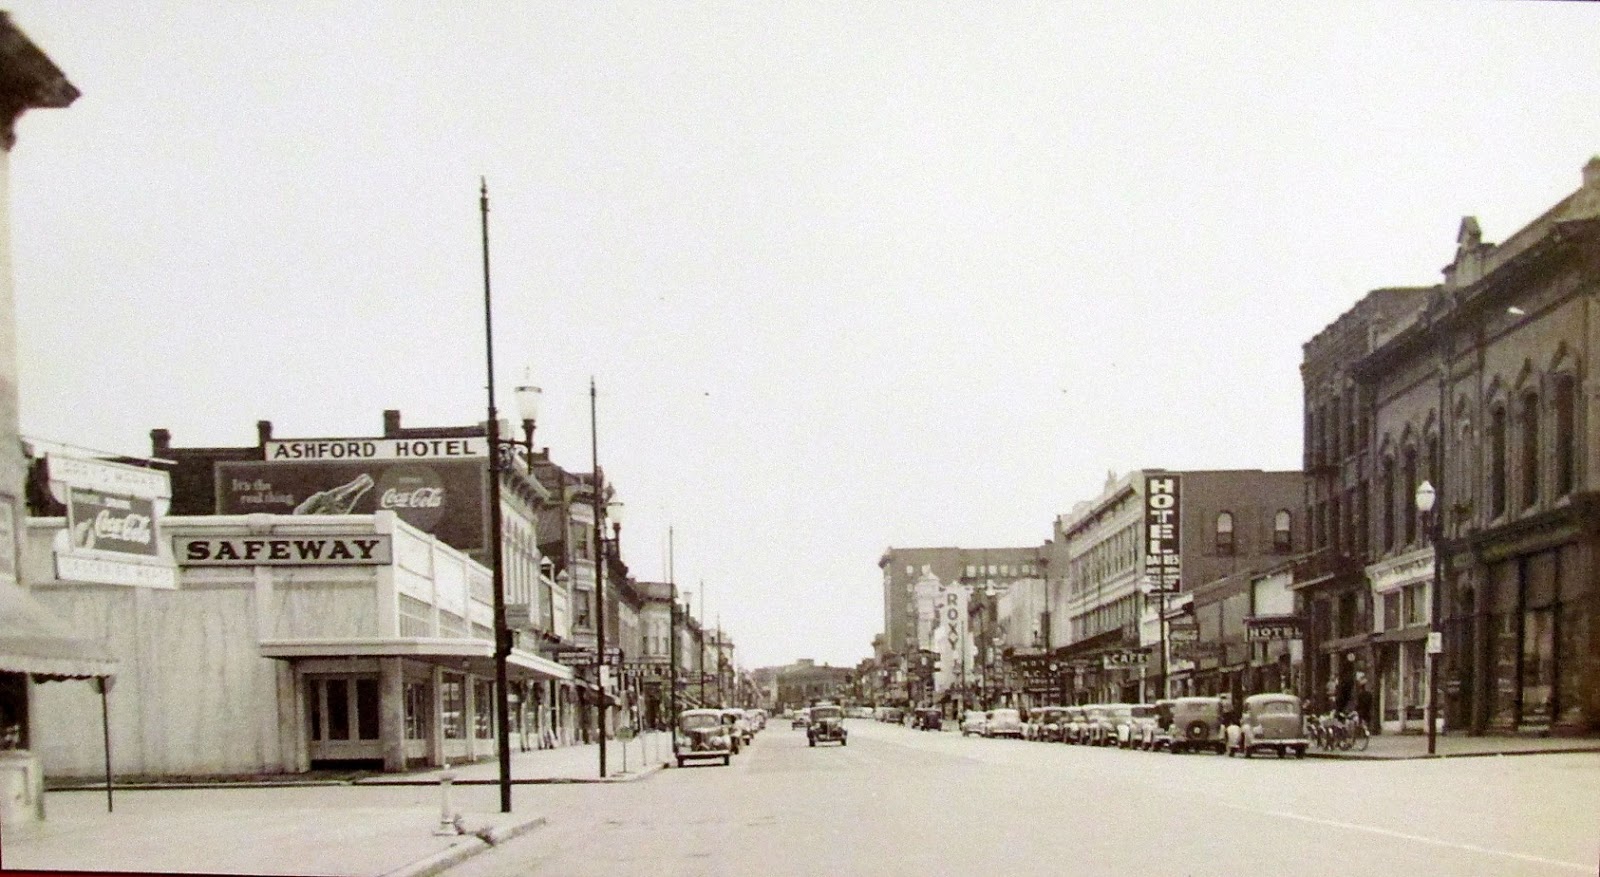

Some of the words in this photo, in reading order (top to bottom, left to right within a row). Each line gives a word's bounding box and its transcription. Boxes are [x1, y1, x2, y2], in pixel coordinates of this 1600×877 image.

[274, 442, 376, 459] ASHFORD
[396, 439, 477, 457] HOTEL
[253, 478, 272, 492] the
[1149, 478, 1175, 554] HOTEL
[187, 540, 380, 561] SAFEWAY
[946, 592, 959, 650] ROXY
[1249, 626, 1303, 641] HOTEL
[1111, 652, 1145, 665] CAFE
